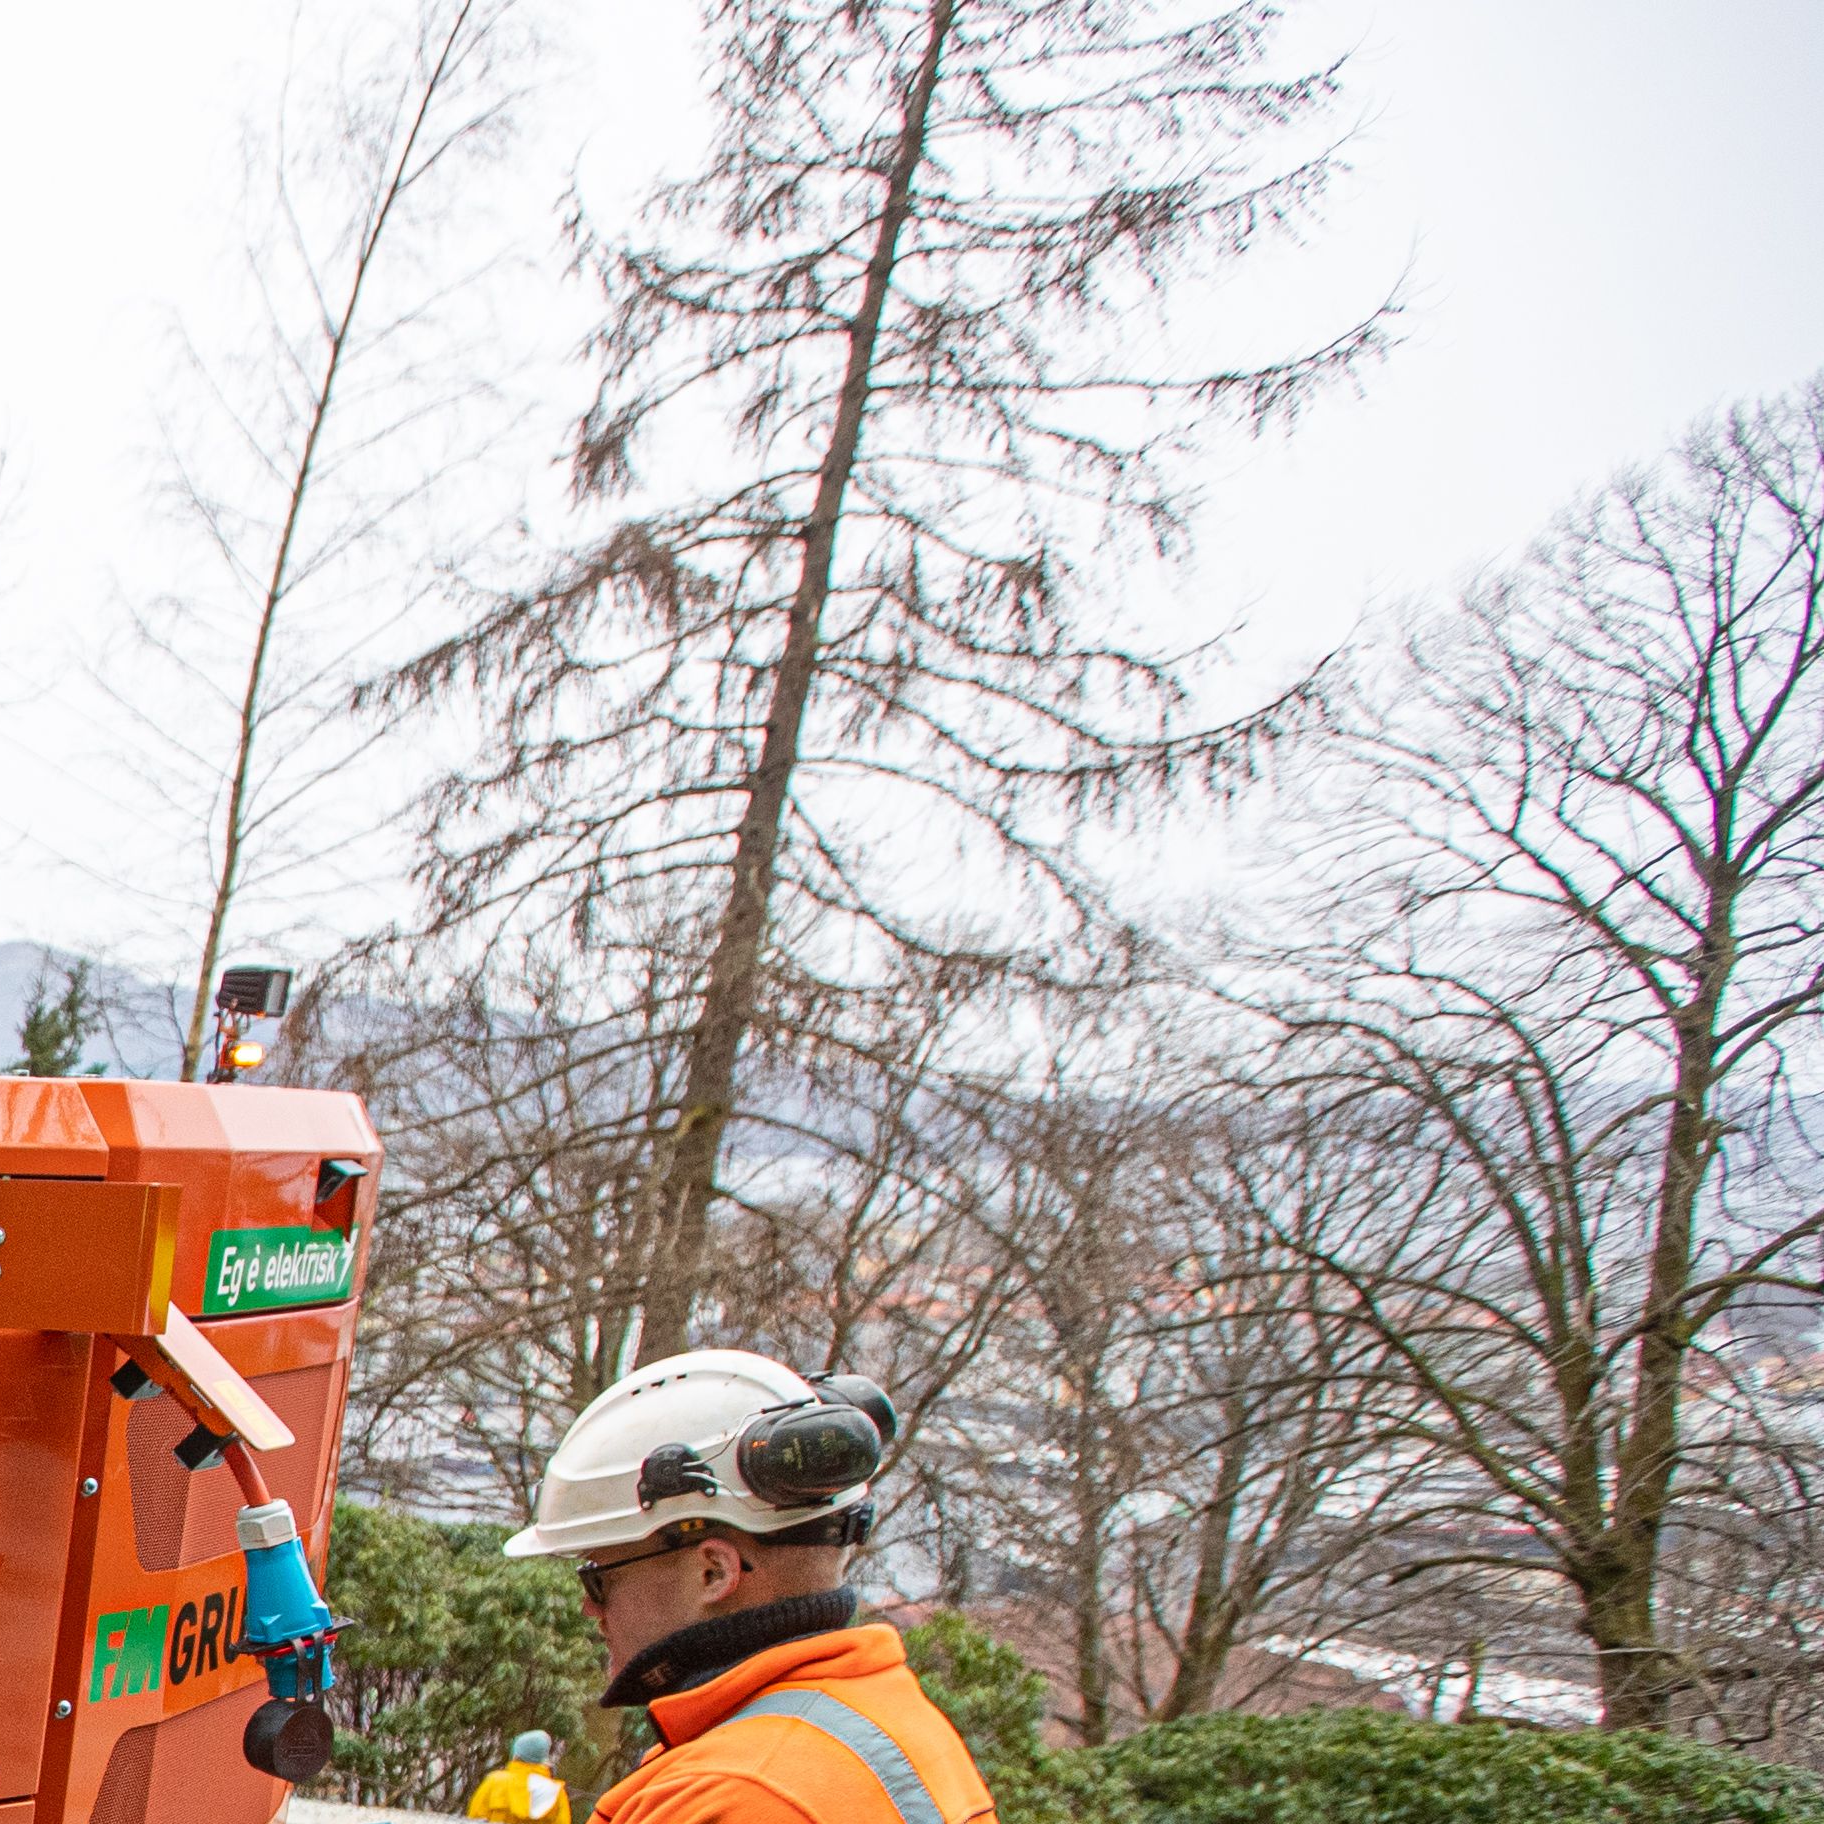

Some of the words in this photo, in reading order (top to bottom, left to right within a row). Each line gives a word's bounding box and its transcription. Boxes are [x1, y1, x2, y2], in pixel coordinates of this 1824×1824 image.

[217, 1246, 245, 1307] Eg
[264, 1241, 340, 1290] elektrisk
[90, 1604, 170, 1703] FM
